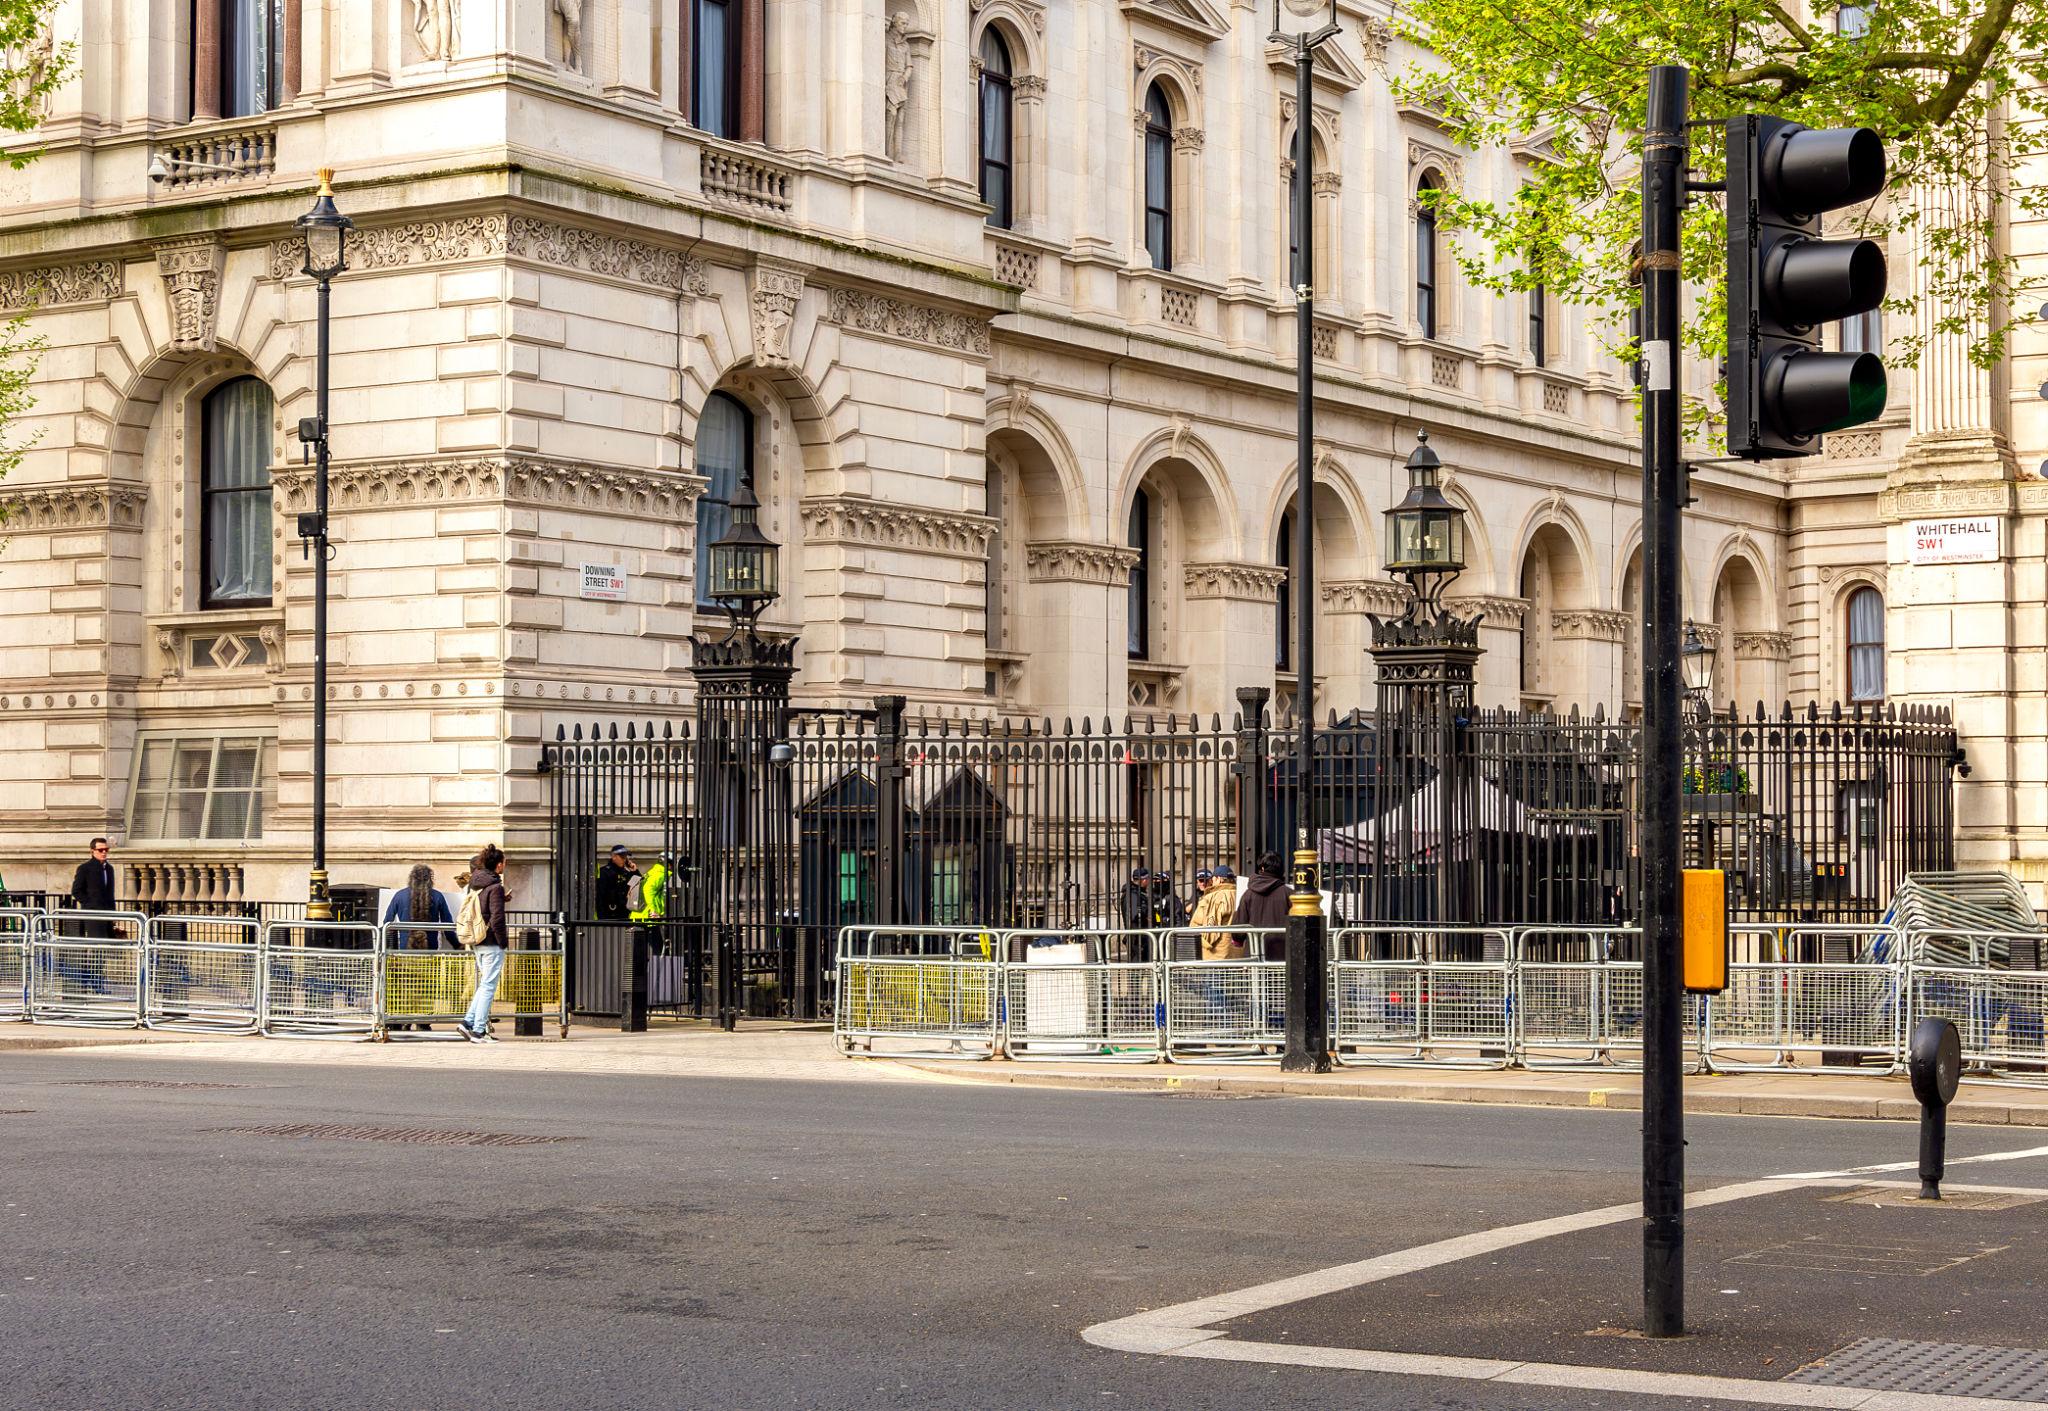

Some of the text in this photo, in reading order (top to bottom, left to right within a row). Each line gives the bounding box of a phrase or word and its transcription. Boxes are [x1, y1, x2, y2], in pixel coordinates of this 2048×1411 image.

[1916, 522, 1991, 535] WHITEHALL
[585, 565, 615, 577] DOWNING
[585, 577, 624, 589] STREET SW1
